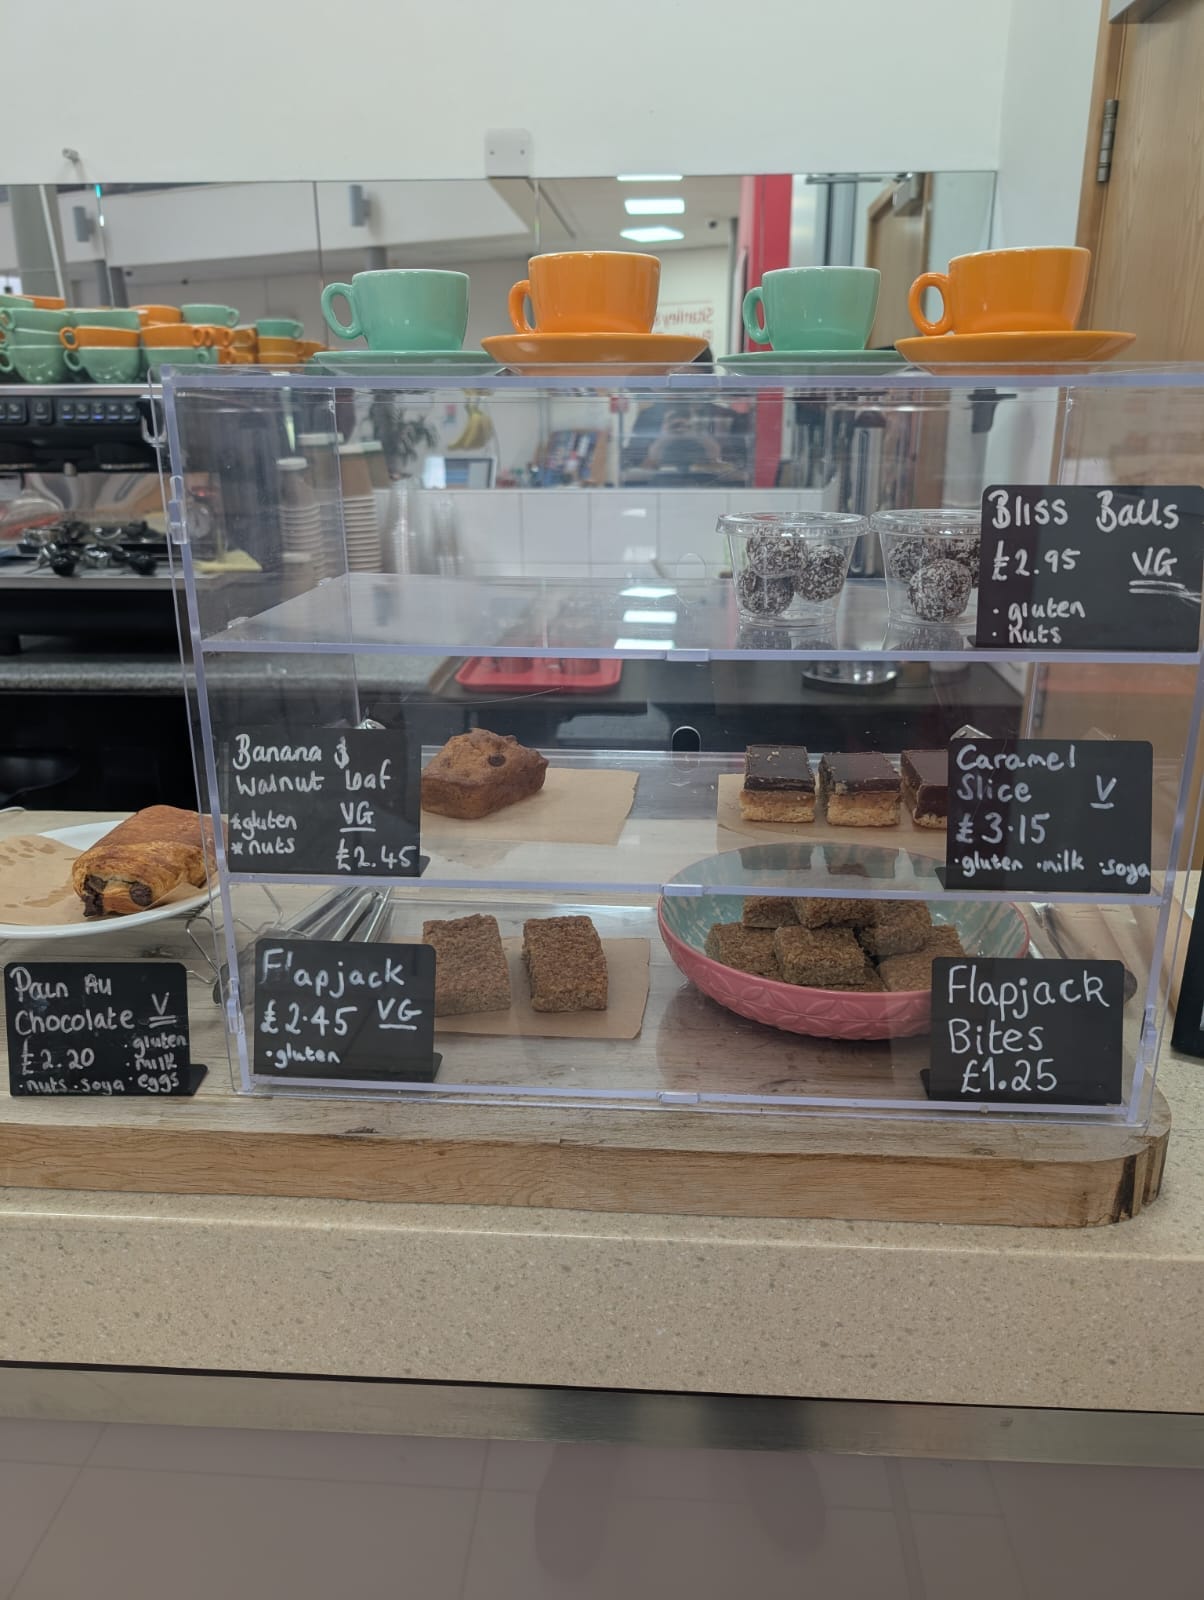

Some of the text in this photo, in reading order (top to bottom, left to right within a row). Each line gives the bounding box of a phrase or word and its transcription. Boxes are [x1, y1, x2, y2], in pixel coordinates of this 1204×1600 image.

[988, 489, 1179, 533] Bliss Balls
[992, 540, 1178, 581] £2.95 VG
[1008, 597, 1086, 629] gluten
[232, 733, 322, 770] Banana
[956, 743, 1076, 771] Caramel
[235, 759, 392, 796] Walnut Loaf
[956, 773, 1117, 802] Slice V
[339, 801, 375, 825] VG
[335, 838, 417, 871] £2.45
[961, 849, 1151, 885] gluten milk soya
[9, 966, 69, 1002] Pain
[259, 948, 405, 998] Flapjack
[377, 998, 423, 1022] VG
[948, 964, 1110, 1021] Flapjack
[14, 992, 170, 1036] Chocolate V
[21, 1032, 188, 1075] £2.20 gluten
[948, 1018, 1044, 1055] Bites
[274, 1042, 341, 1069] gluten
[26, 1071, 180, 1096] nuts soya eggs
[961, 1056, 1057, 1093] £1.25
